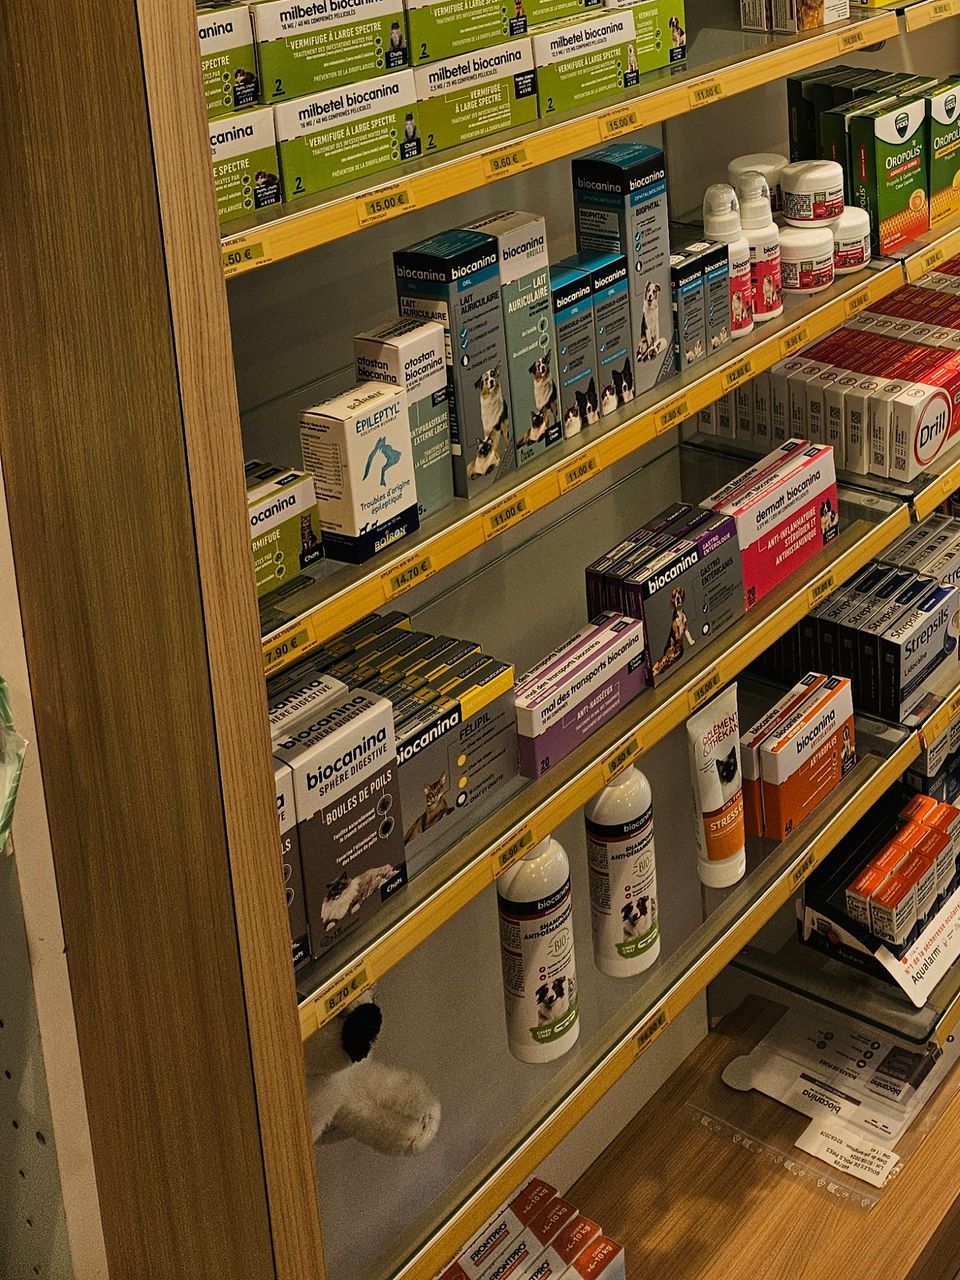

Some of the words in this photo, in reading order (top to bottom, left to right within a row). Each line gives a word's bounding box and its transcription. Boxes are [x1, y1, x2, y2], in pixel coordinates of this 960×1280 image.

[280, 0, 327, 23] milbetel
[290, 33, 328, 50] VERMIFUGE
[334, 28, 355, 40] LARGE
[355, 22, 382, 36] SPECTRE
[550, 32, 583, 51] milbetel
[585, 21, 624, 39] biocanina
[298, 95, 344, 121] milbetel
[347, 82, 399, 108] biocanina
[493, 155, 511, 170] 9.60
[629, 169, 664, 192] biocanina
[370, 197, 396, 213] 15.00
[502, 236, 544, 261] biocanina
[451, 254, 497, 280] biocanina
[532, 275, 547, 289] LAIT
[508, 287, 548, 314] AURICULAIRE
[404, 350, 435, 369] otostan
[405, 357, 443, 382] biocanina
[355, 402, 399, 434] ÉPILEPTYL
[919, 411, 947, 445] Drill
[756, 495, 785, 523] dermatt
[786, 471, 821, 501] biocanina
[767, 509, 816, 550] ANTI-INFLAMMATOIRE
[648, 551, 698, 595] biocanina
[891, 611, 922, 639] Strepsils
[904, 608, 949, 661] Strepsils
[541, 701, 556, 718] mal
[557, 688, 570, 706] des
[571, 660, 606, 693] transports
[607, 634, 639, 666] biocanina
[796, 709, 835, 754] biocanina
[307, 726, 387, 791] biocanina
[319, 771, 349, 797] SPHÈRE
[351, 744, 388, 777] DIGESTIVE
[326, 796, 357, 826] BOULES
[371, 770, 392, 795] POILS
[710, 809, 738, 831] STRESS
[911, 946, 941, 985] Aqualarm
[470, 1222, 507, 1262] FRONTPRO
